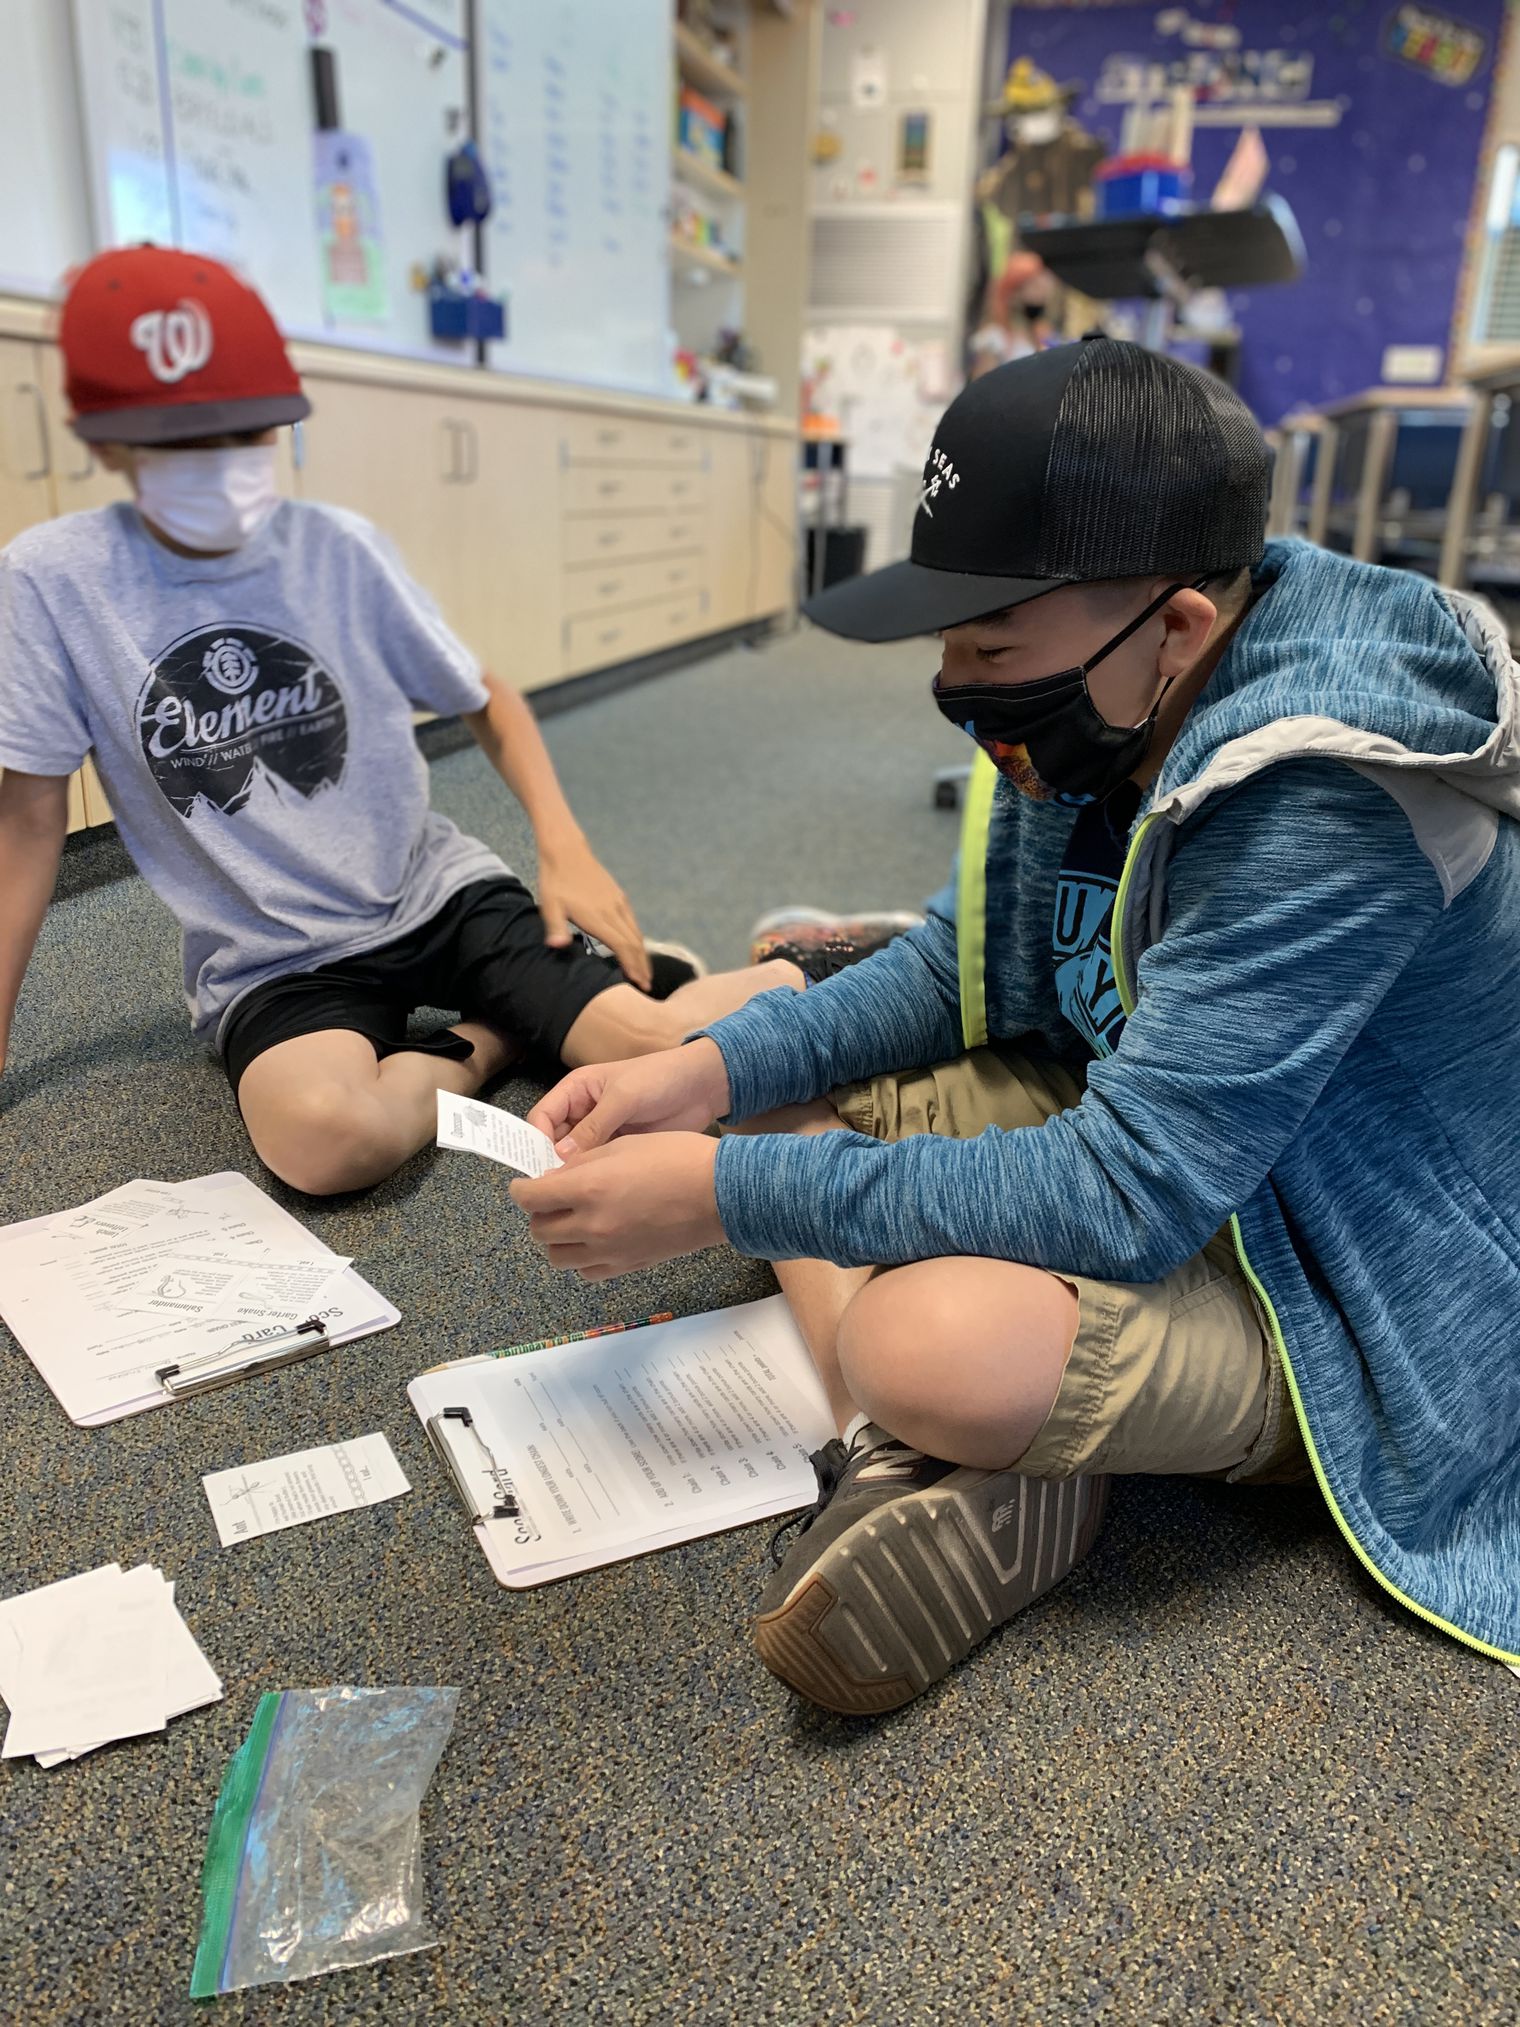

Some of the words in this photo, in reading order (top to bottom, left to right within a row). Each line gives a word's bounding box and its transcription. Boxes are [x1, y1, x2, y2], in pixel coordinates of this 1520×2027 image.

[931, 448, 960, 489] SEAS
[141, 666, 322, 758] Element
[170, 756, 206, 769] WIND
[148, 1299, 204, 1313] Salamander
[237, 1307, 266, 1316] Snake
[267, 1311, 298, 1320] Garter
[233, 1520, 249, 1536] Ant
